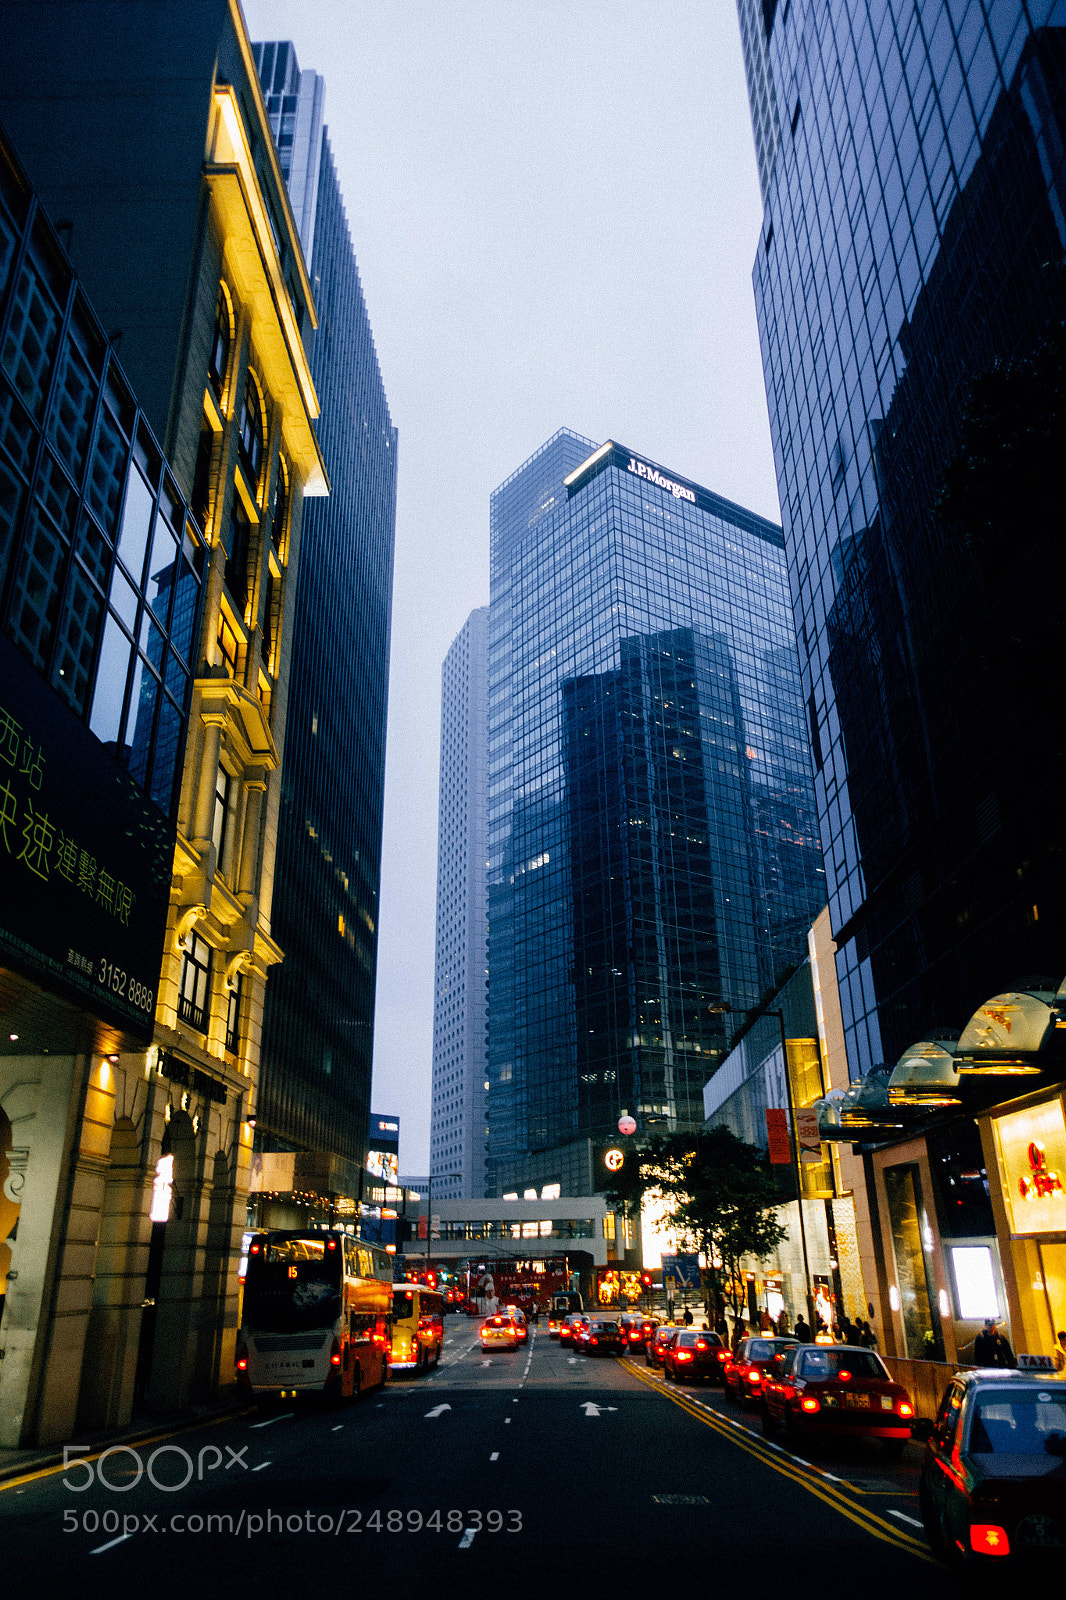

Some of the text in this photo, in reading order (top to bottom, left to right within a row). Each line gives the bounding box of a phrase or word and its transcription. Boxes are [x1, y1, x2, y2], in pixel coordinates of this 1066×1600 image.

[627, 458, 696, 503] J.P.Morgan
[98, 957, 127, 997] 3152
[128, 977, 153, 1013] 8888
[287, 1265, 298, 1279] 15
[1021, 1356, 1051, 1367] TAXI
